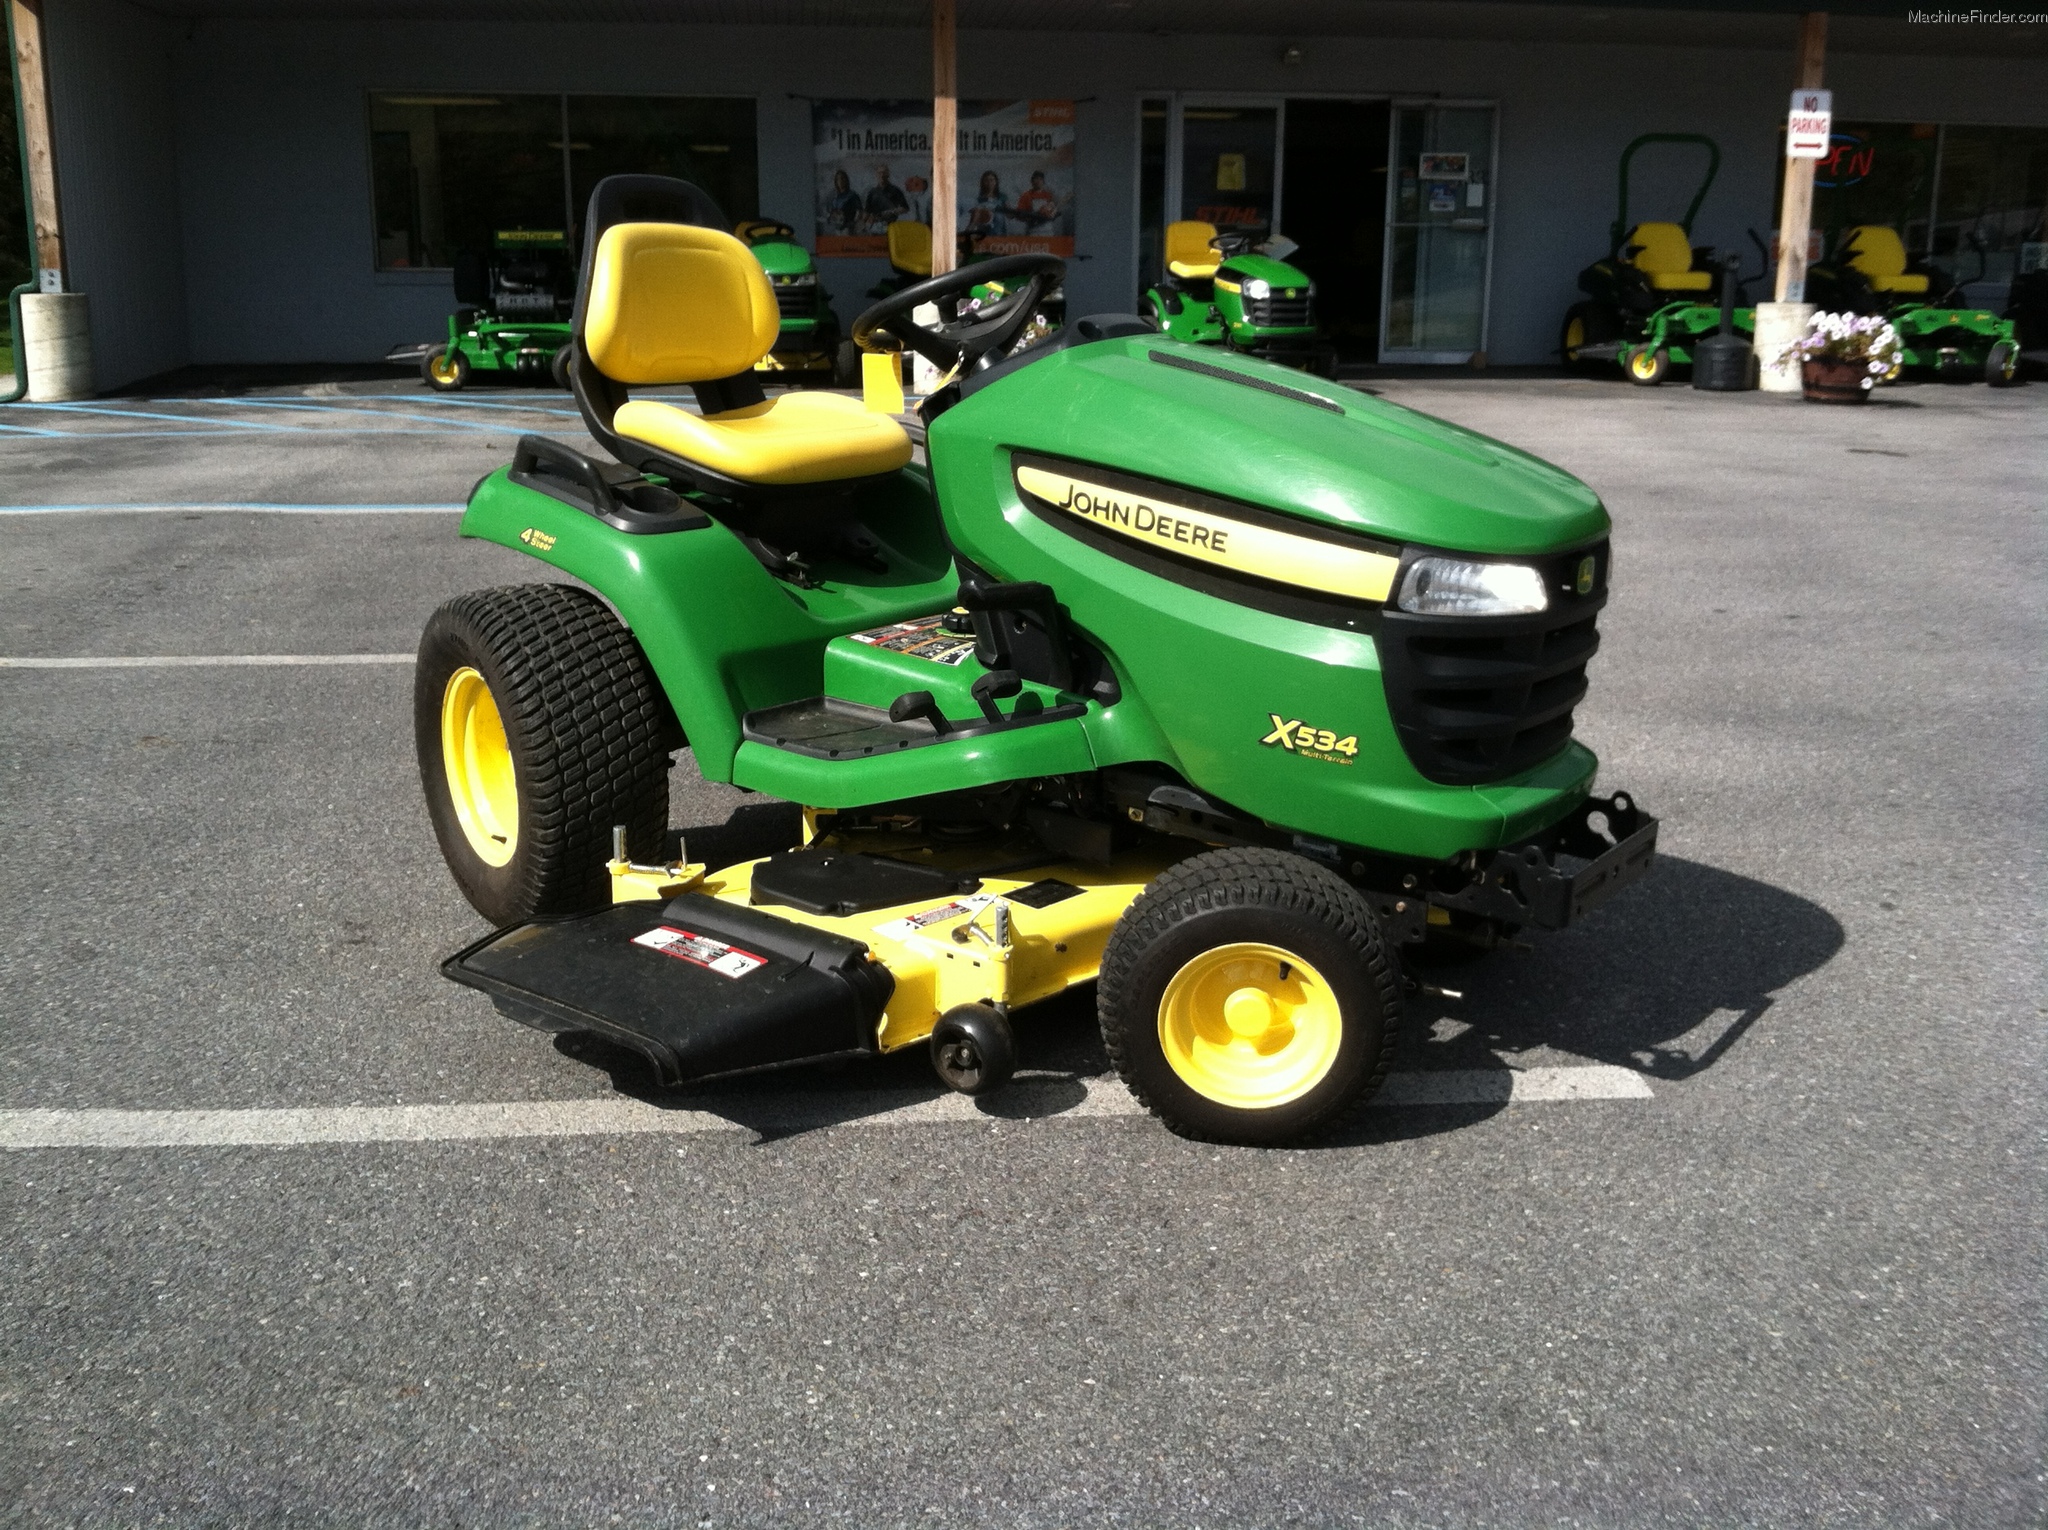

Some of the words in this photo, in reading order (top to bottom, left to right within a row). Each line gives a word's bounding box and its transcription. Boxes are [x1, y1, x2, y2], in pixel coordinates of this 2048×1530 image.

[1803, 96, 1818, 113] NO
[1792, 117, 1827, 135] PARKING
[847, 129, 861, 151] in
[865, 128, 932, 152] America.
[973, 130, 987, 151] in
[991, 129, 1057, 152] America.
[1058, 484, 1130, 527] JOHN
[1133, 504, 1229, 554] DEERE
[520, 528, 533, 543] 4
[1260, 712, 1359, 757] X534
